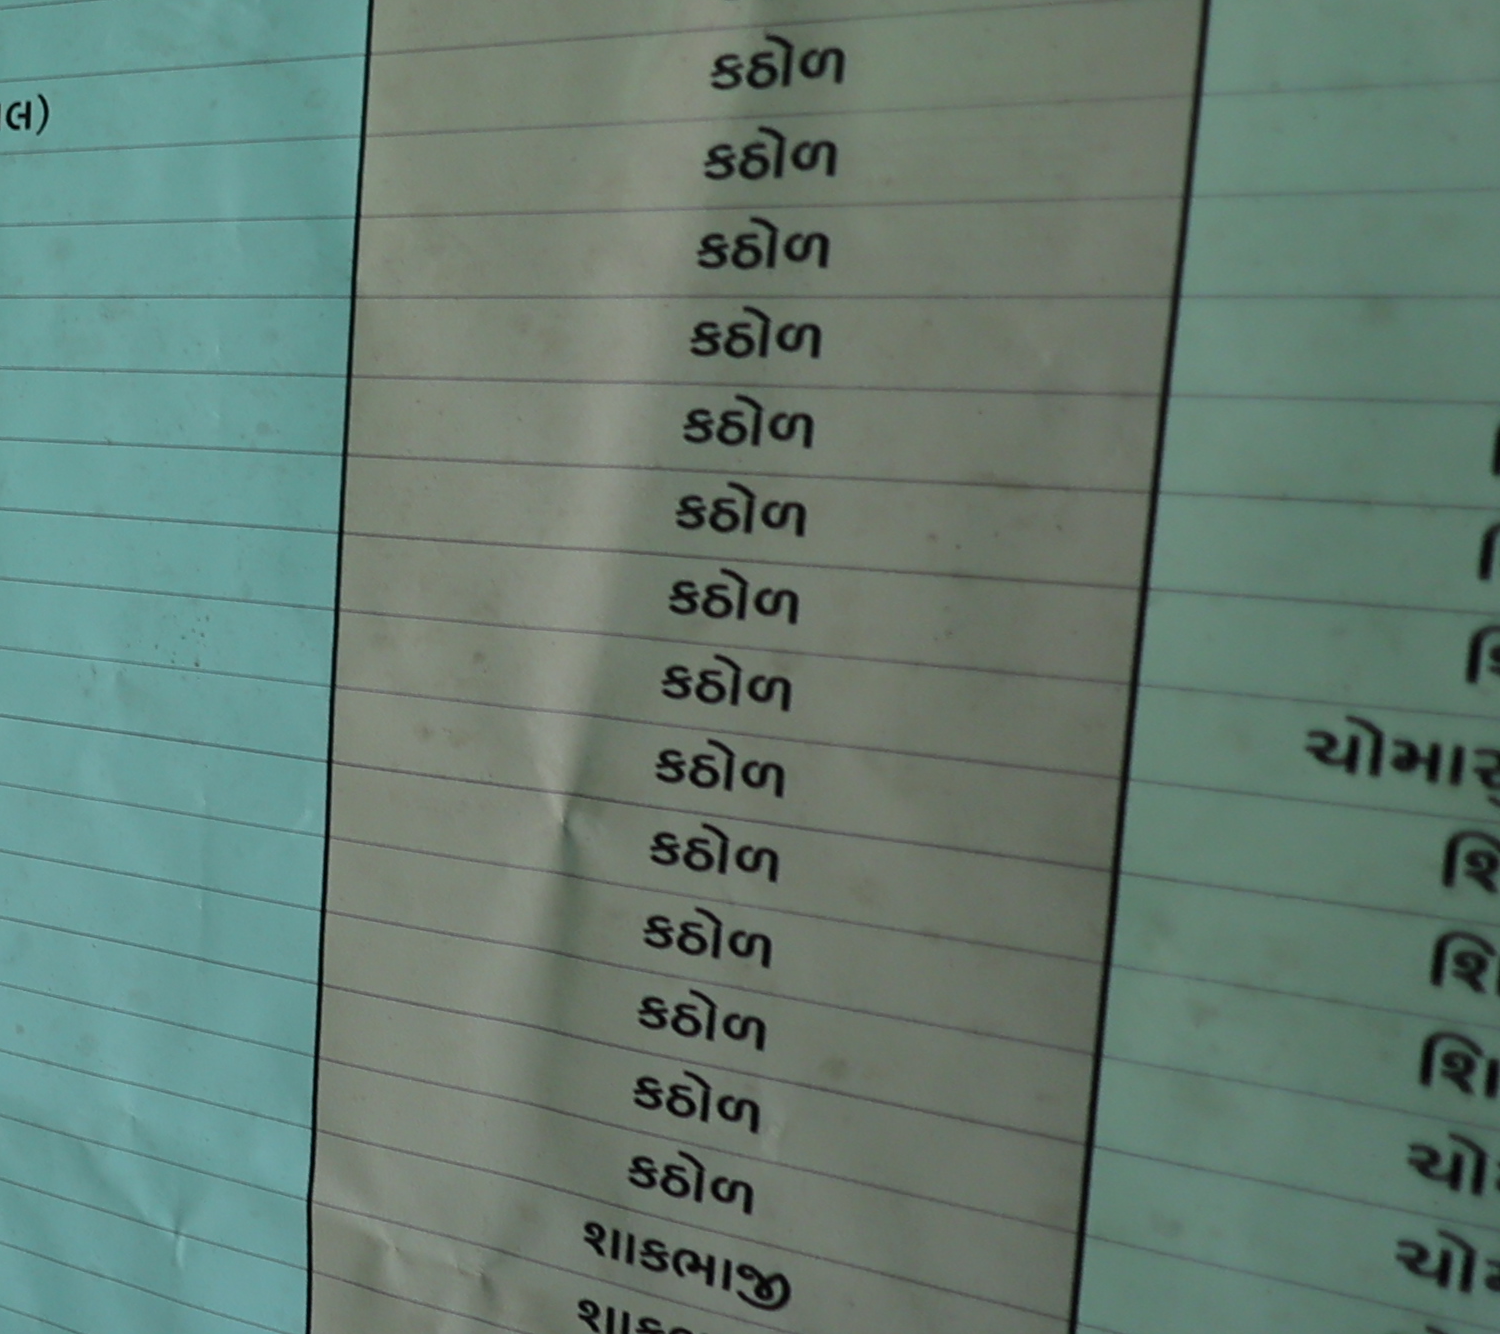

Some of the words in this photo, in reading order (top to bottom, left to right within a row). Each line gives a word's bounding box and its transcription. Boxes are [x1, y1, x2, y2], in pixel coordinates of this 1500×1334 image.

[705, 126, 837, 180] કઠોળ
[691, 306, 821, 359] કઠોળ
[676, 482, 806, 537] કઠોળ
[662, 654, 791, 712] કઠોળ
[650, 823, 779, 882] કઠોળ
[638, 989, 766, 1051] કઠોળ
[628, 1151, 754, 1215] કઠોળ
[584, 1221, 791, 1311] શાકભાજી
